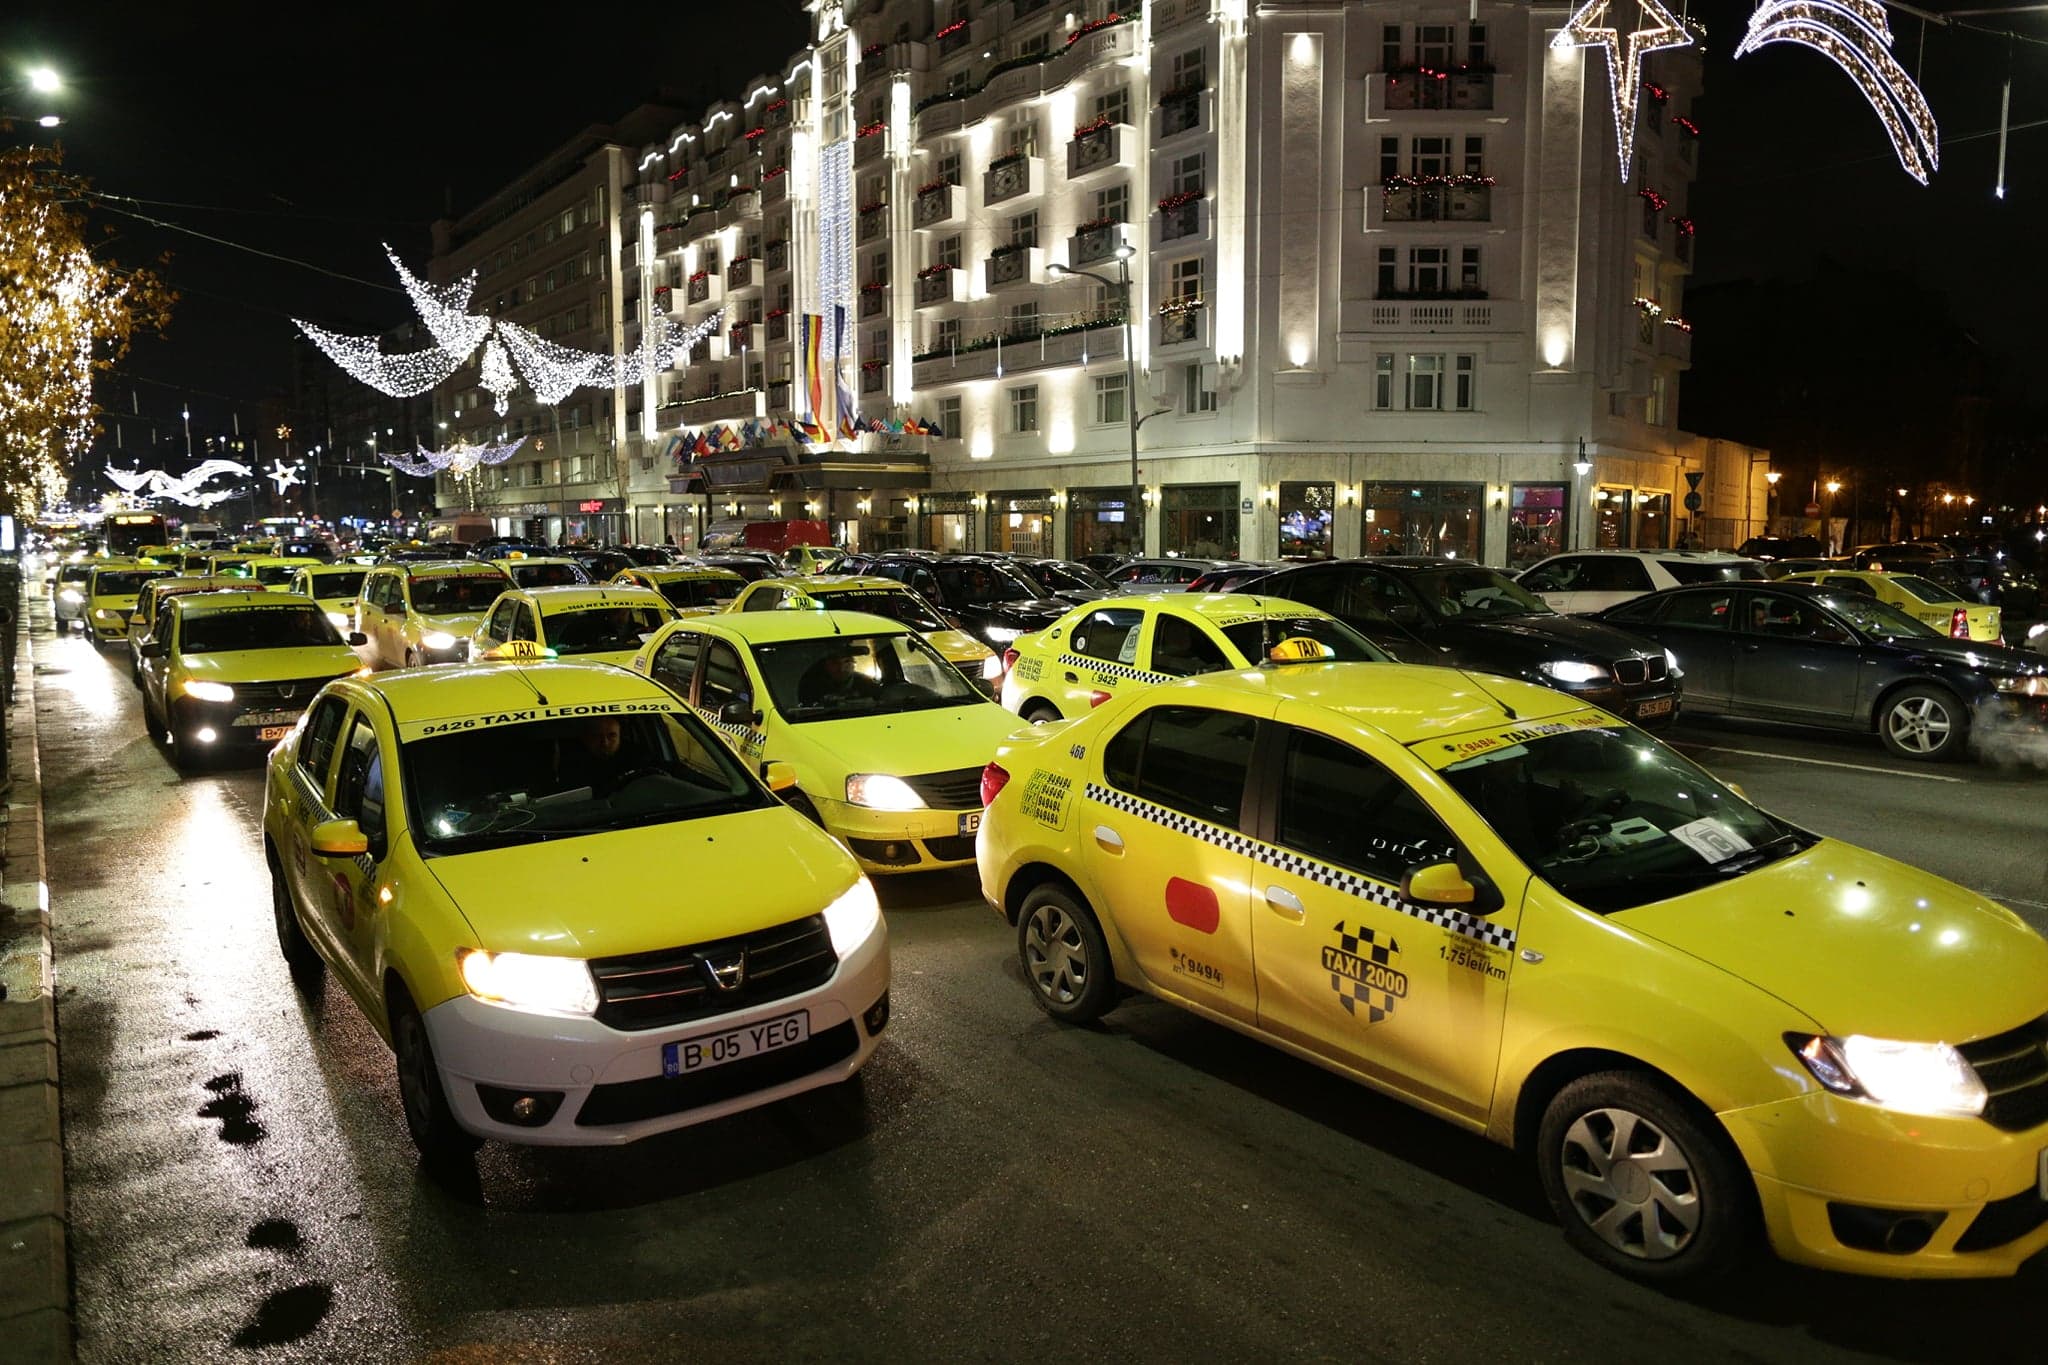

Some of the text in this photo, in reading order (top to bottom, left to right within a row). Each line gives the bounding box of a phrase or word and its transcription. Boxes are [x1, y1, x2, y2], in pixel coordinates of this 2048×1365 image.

[792, 597, 811, 608] TAXI
[511, 641, 537, 657] TAXI
[1293, 639, 1320, 658] TAXI
[1097, 673, 1118, 687] 9425
[423, 703, 671, 735] 9426 TAXI LEONE 9426
[1465, 737, 1497, 752] 9494
[1500, 728, 1539, 744] TAXI
[1535, 722, 1571, 736] 2000
[1069, 743, 1086, 760] 468
[1046, 773, 1072, 789] 949494
[1040, 784, 1066, 800] 949494
[970, 814, 980, 830] B
[1035, 807, 1059, 825] 949494
[1187, 958, 1221, 982] 9494
[1324, 950, 1406, 995] TAXI 2000
[750, 1018, 799, 1051] YEG
